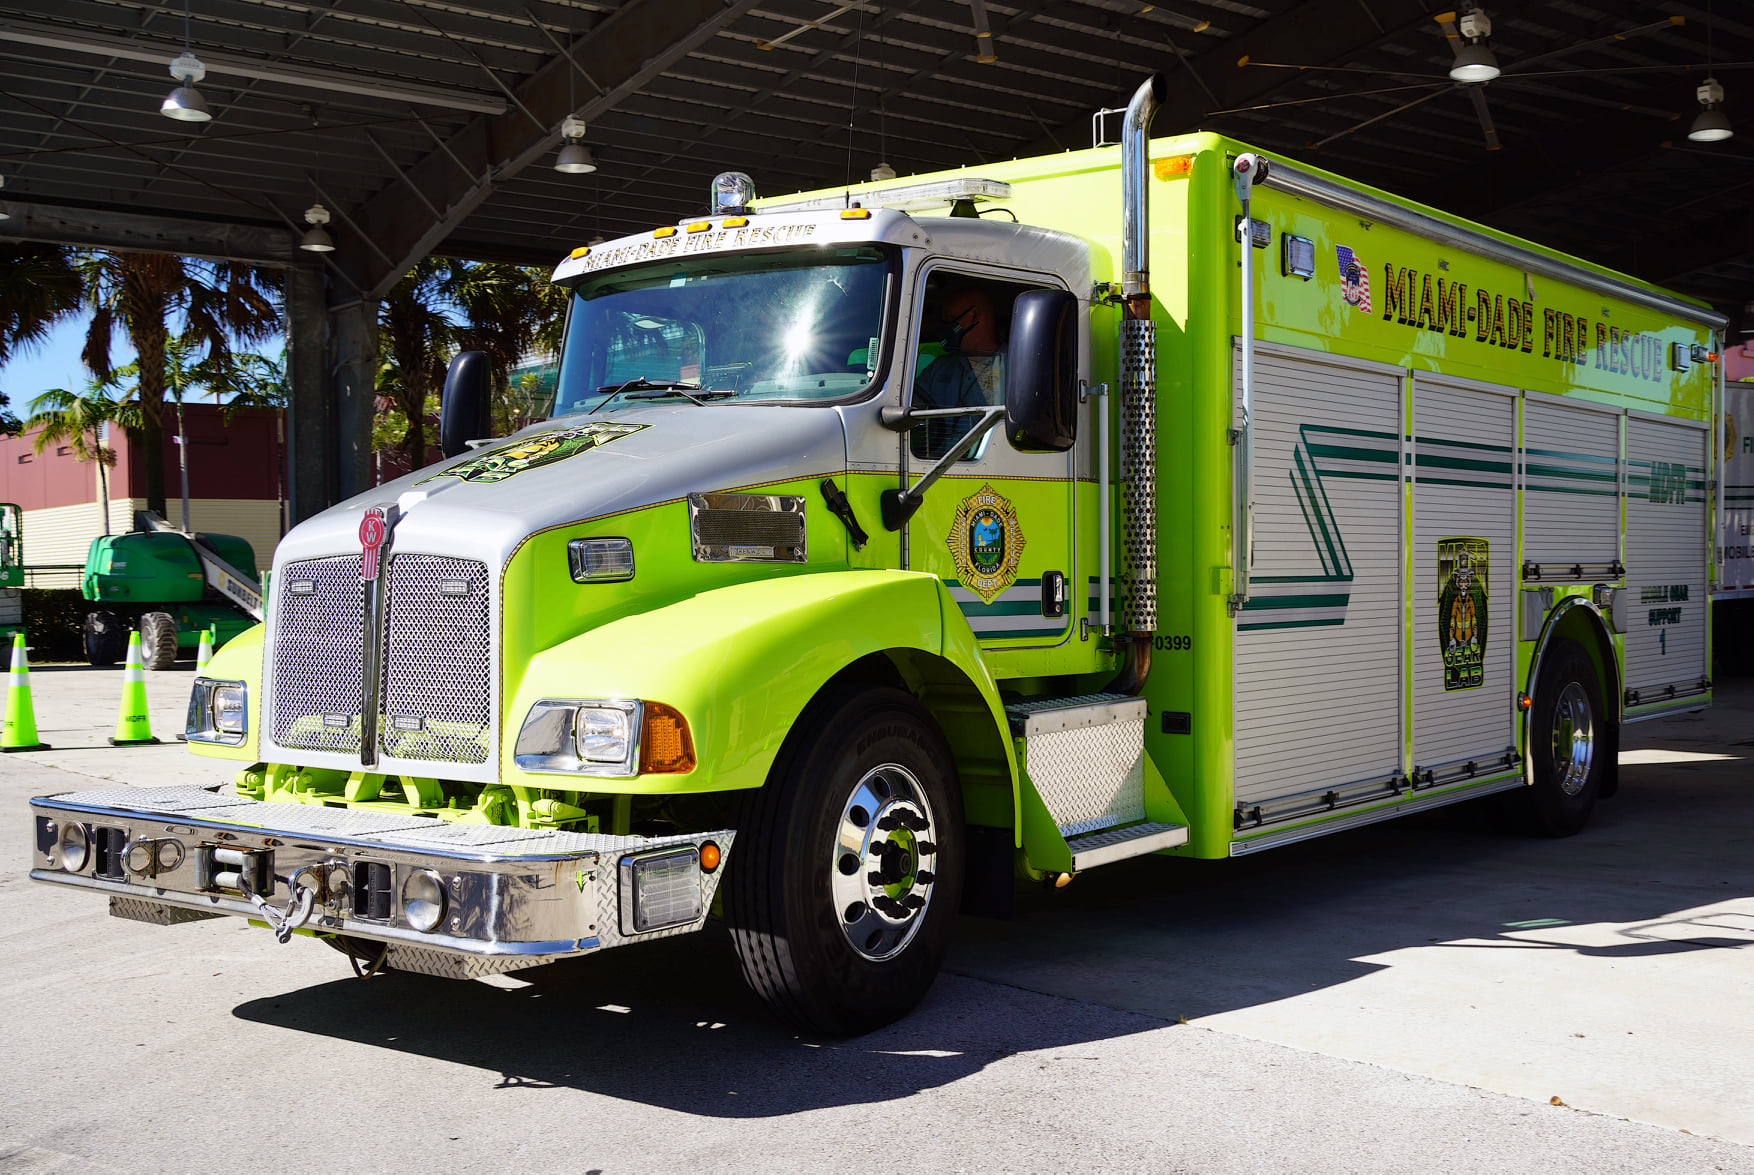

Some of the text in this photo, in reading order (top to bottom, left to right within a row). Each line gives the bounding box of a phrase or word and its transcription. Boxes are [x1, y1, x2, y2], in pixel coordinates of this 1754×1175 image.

[582, 223, 817, 273] MIAMI-DADE FIRE RESCUE
[1383, 263, 1663, 382] MIAMI-DADE FIRE RESCUE
[977, 494, 996, 505] FIRE
[974, 562, 1000, 574] FLORIDA
[1153, 635, 1192, 651] 0399
[1659, 628, 1666, 655] 1
[1446, 666, 1483, 689] LAB
